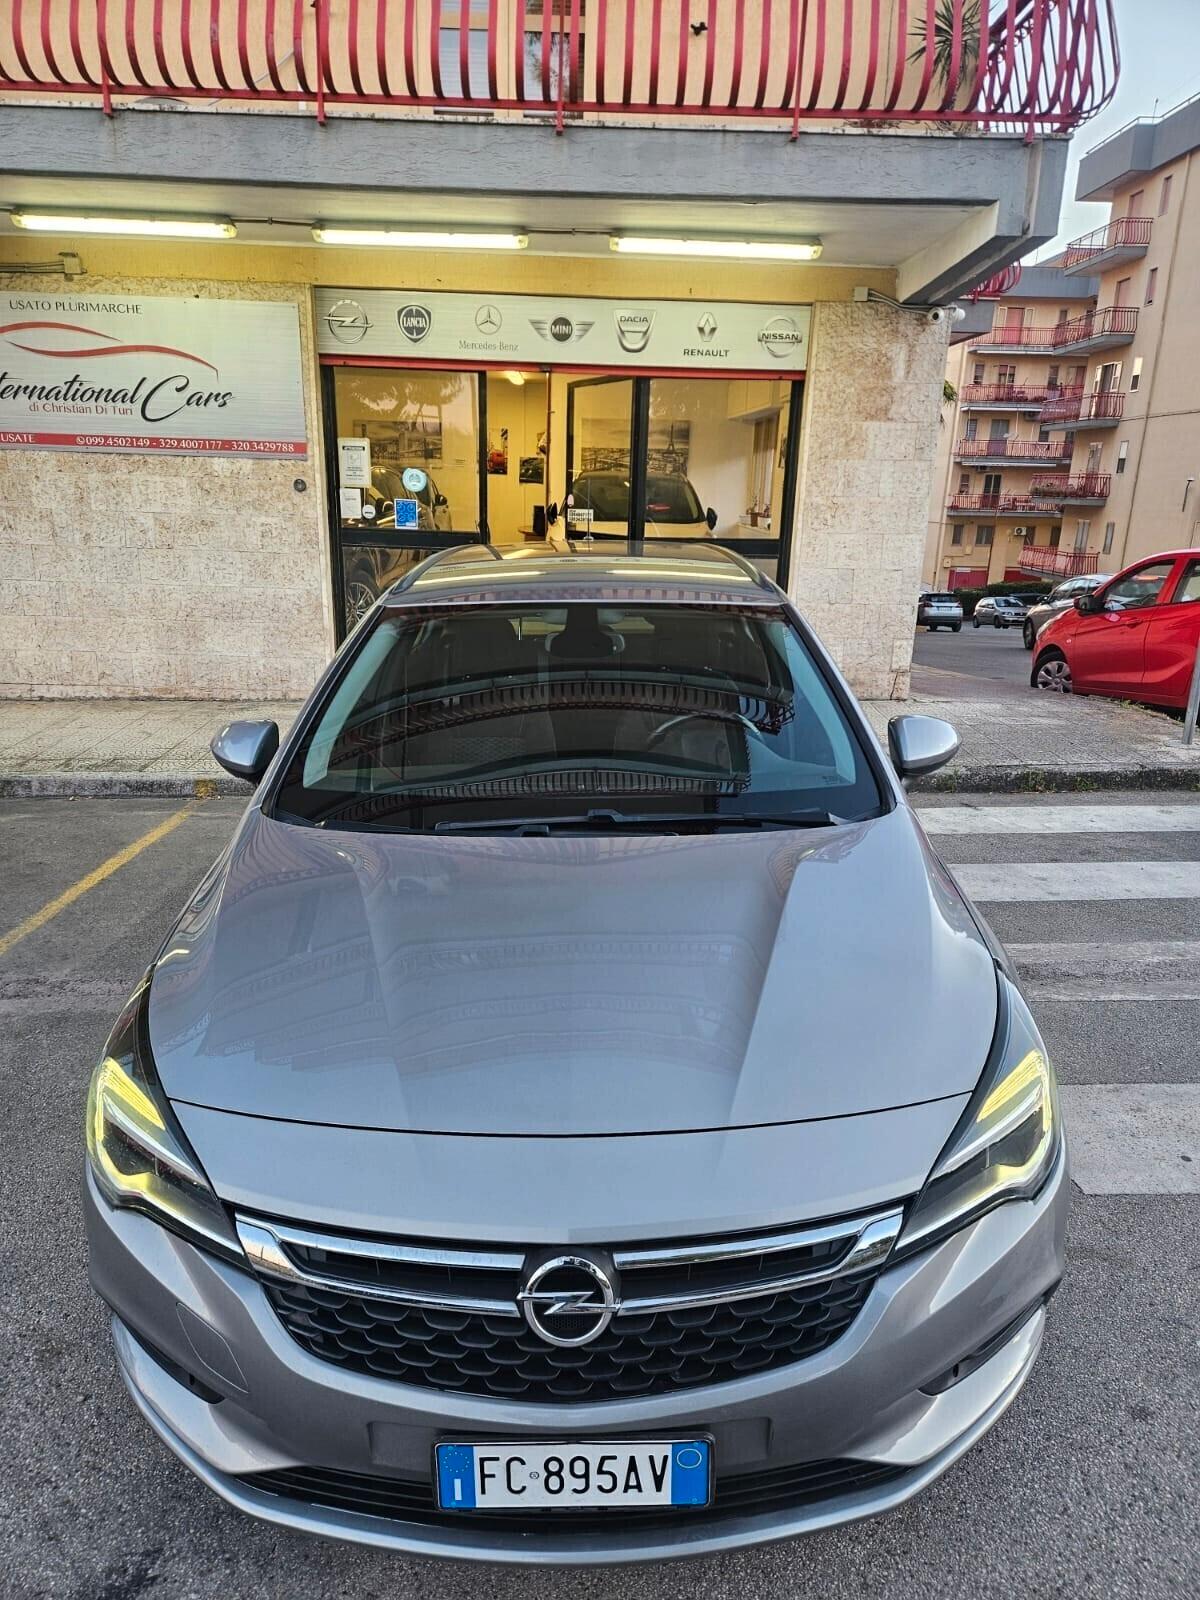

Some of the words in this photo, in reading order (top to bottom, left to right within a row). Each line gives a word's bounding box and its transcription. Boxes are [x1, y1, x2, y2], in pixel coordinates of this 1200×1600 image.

[9, 299, 51, 311] USATO
[55, 300, 143, 314] PLURIMARCHE
[403, 317, 426, 328] LANCIA
[619, 315, 649, 323] DACIA
[551, 325, 572, 335] MINI
[761, 332, 799, 341] NISSAN
[683, 349, 730, 357] RENAULT
[140, 374, 236, 423] Cars
[29, 402, 39, 412] di
[42, 402, 92, 414] Christian
[95, 405, 108, 415] Di
[0, 433, 36, 443] USATE
[85, 435, 150, 448] 099.4502149
[159, 438, 222, 450] 329.4007177
[231, 441, 295, 453] 320.3429788
